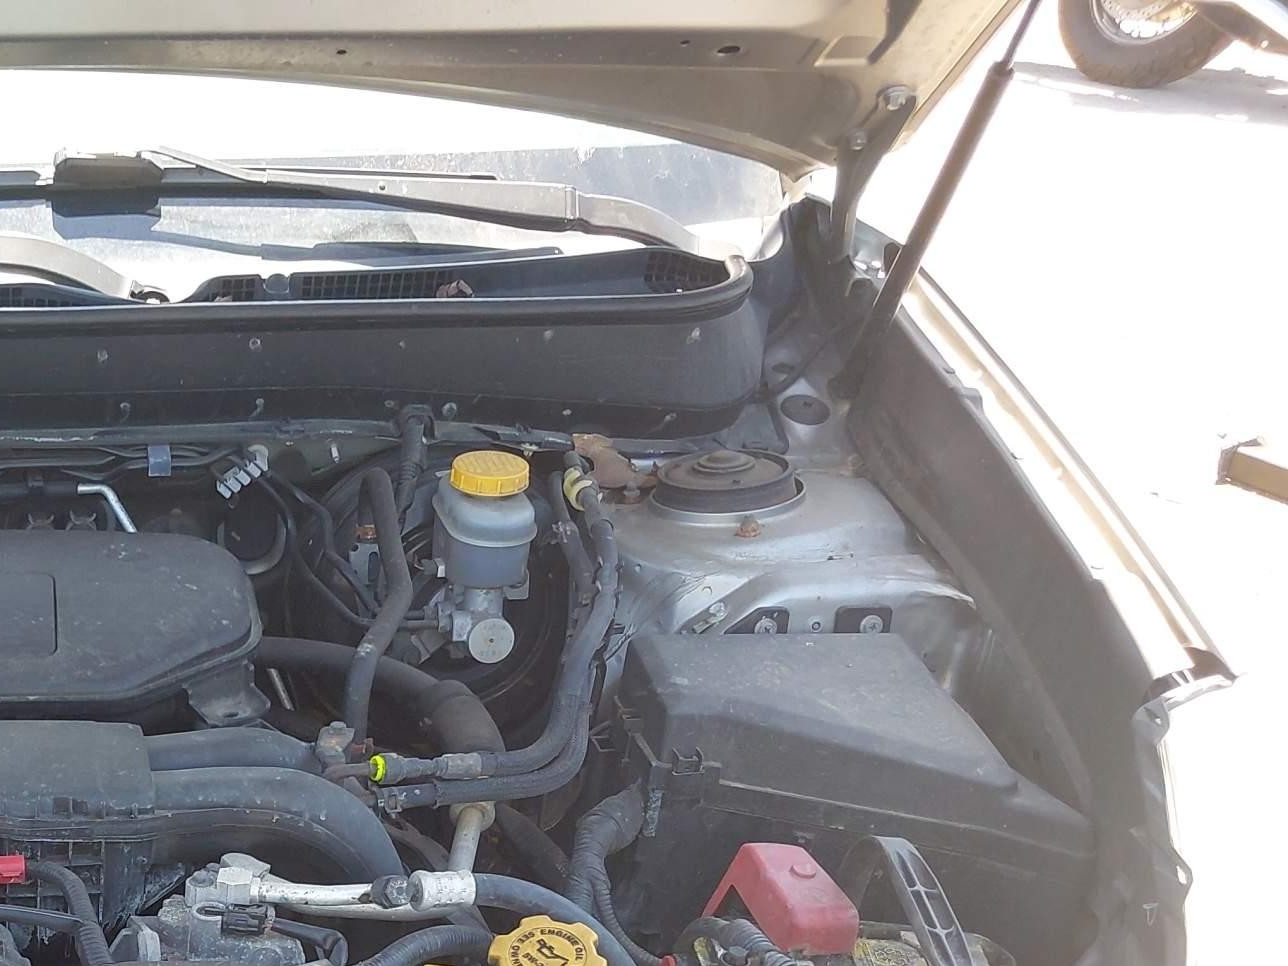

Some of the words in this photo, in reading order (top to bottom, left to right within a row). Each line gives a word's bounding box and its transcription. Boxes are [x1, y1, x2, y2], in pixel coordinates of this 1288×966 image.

[518, 932, 535, 944] SEE
[540, 929, 579, 945] ENGINE
[575, 947, 584, 961] OIL
